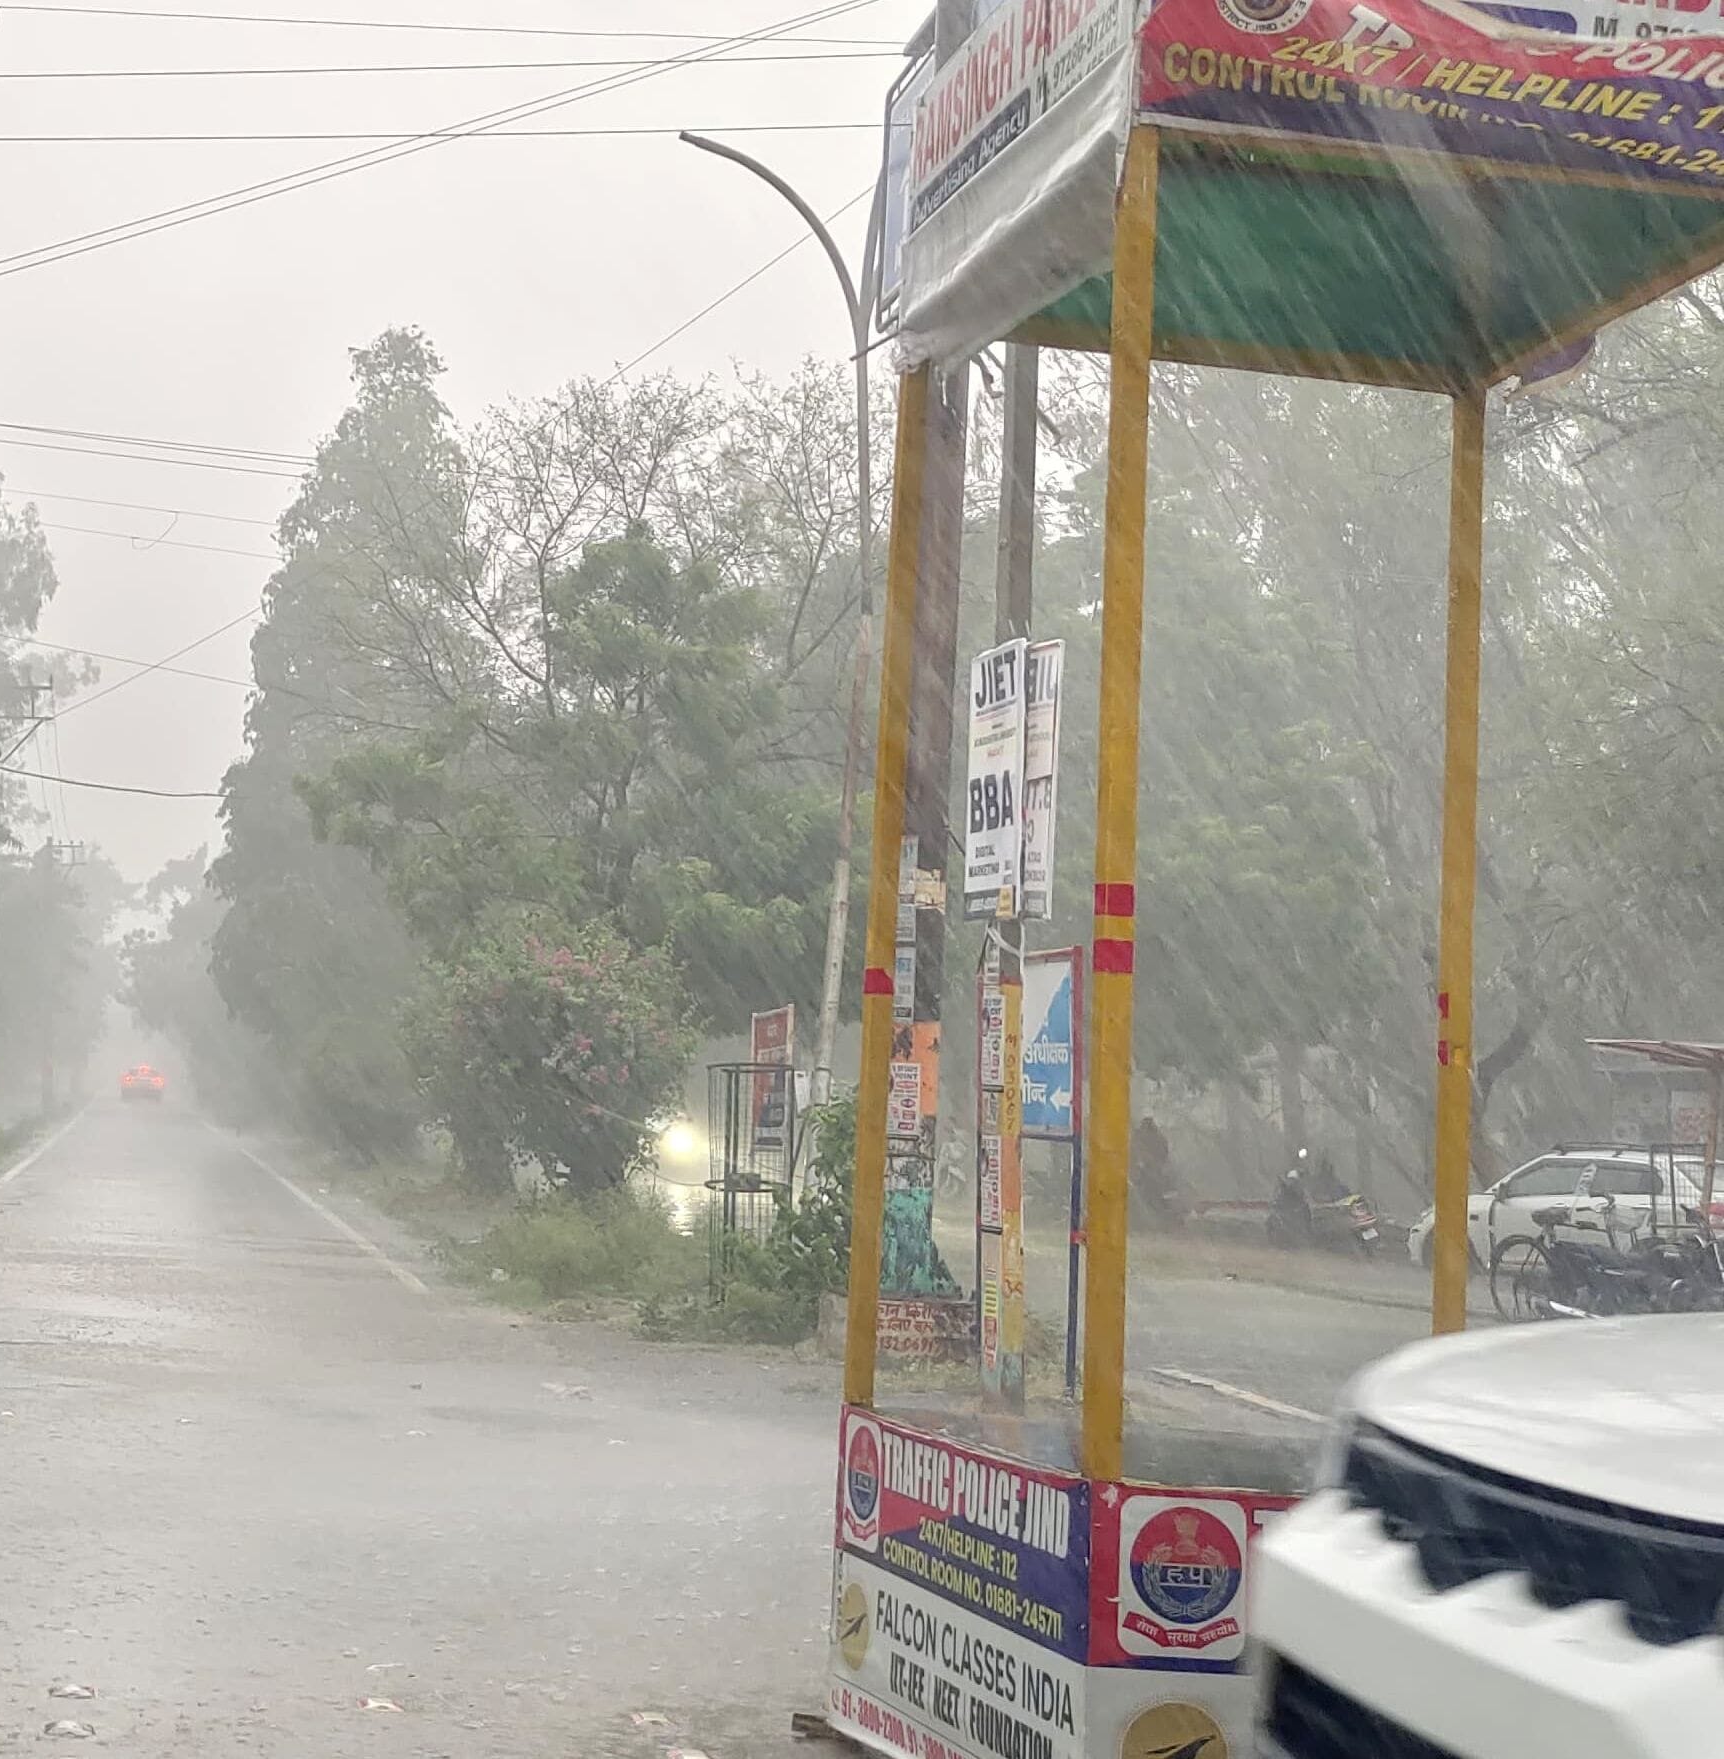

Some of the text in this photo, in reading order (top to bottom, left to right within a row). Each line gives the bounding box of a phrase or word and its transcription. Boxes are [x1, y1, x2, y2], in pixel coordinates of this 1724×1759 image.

[913, 12, 1015, 183] RAMSINGH
[1422, 57, 1663, 122] HELPLINE
[913, 103, 1027, 226] Advertising Agency
[975, 648, 1017, 708] JIET
[969, 770, 1014, 834] BBA
[1024, 1034, 1068, 1065] अधीक्षक
[883, 1432, 949, 1511] TRAFFIC
[952, 1455, 1021, 1540] POLICE
[1023, 1480, 1070, 1559] JIND
[883, 1536, 930, 1580] CONTROL
[931, 1558, 963, 1593] ROOM
[876, 1590, 937, 1660] FALCON
[941, 1623, 1016, 1701] CLASSES
[1022, 1661, 1075, 1736] INDIA
[890, 1651, 925, 1710] IIT-JEE
[933, 1675, 961, 1731] NEET
